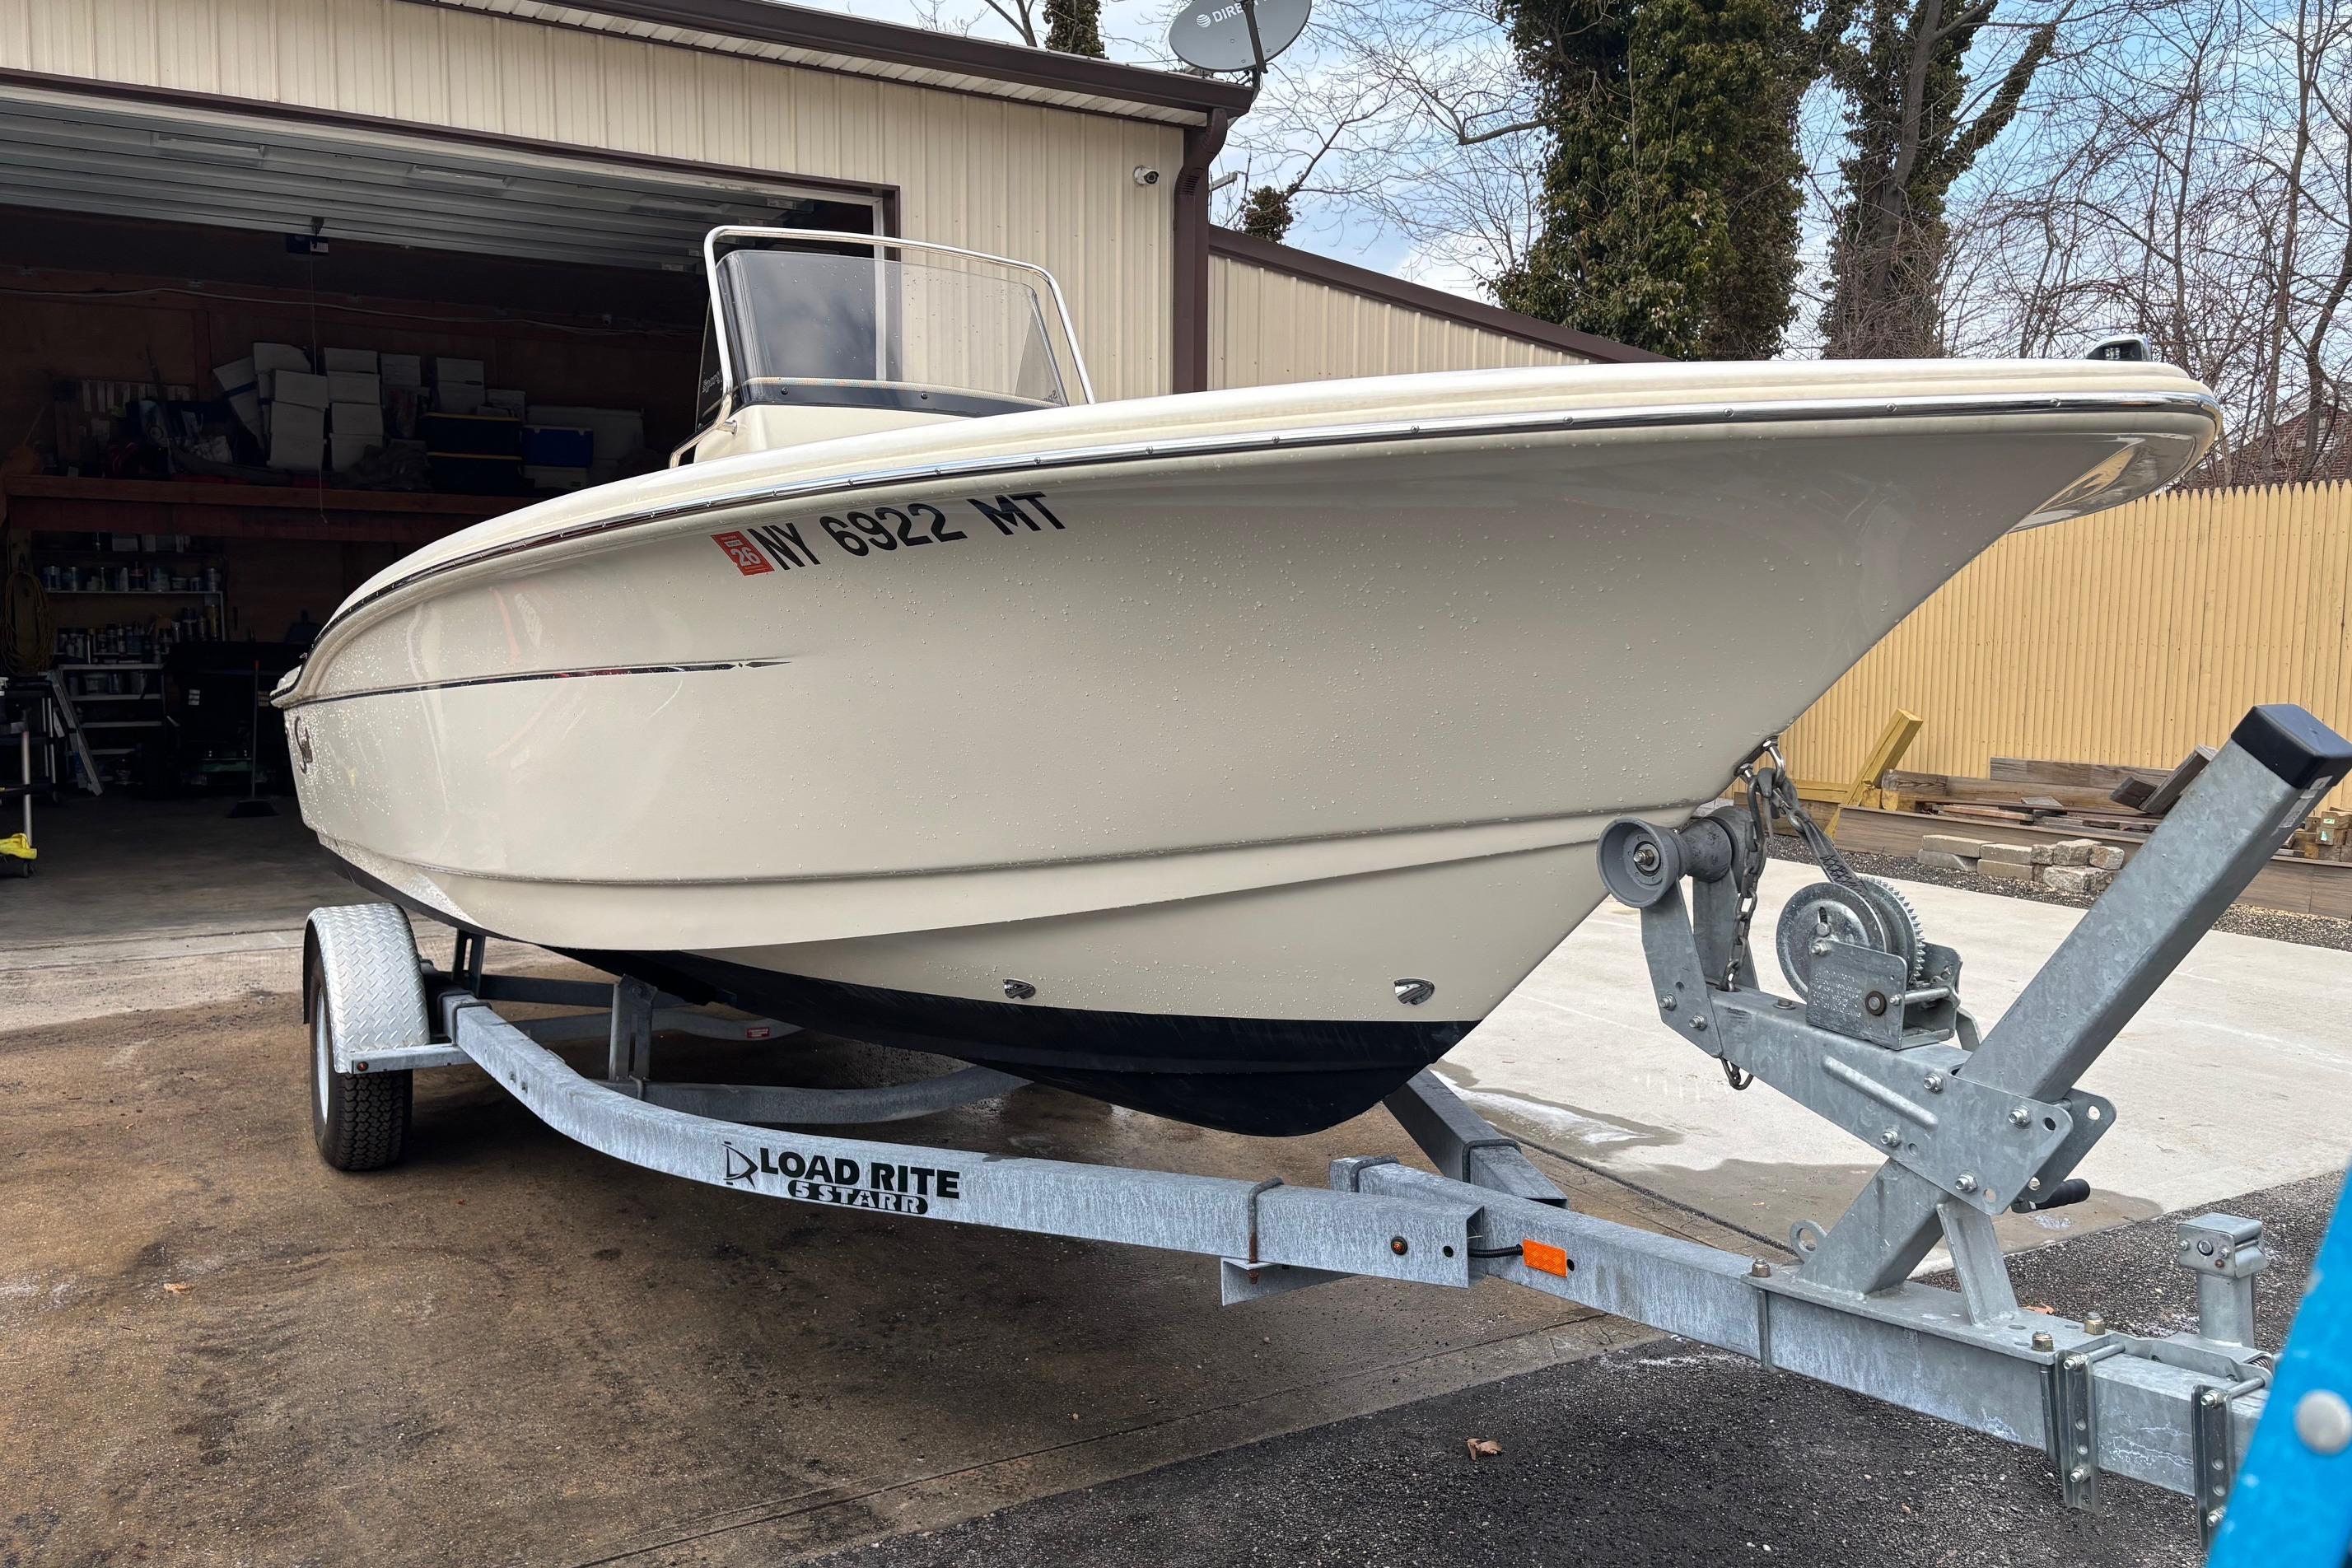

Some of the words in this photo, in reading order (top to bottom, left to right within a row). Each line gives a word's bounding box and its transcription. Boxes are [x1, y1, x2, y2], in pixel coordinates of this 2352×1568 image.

[1212, 0, 1267, 23] DIRE
[747, 523, 821, 570] NY
[819, 502, 968, 557] 6922
[966, 491, 1066, 535] MT
[730, 546, 761, 567] 26
[760, 1147, 860, 1185] LOAD
[870, 1162, 960, 1199] RITE
[795, 1181, 810, 1198] 5
[818, 1184, 920, 1214] STARR
